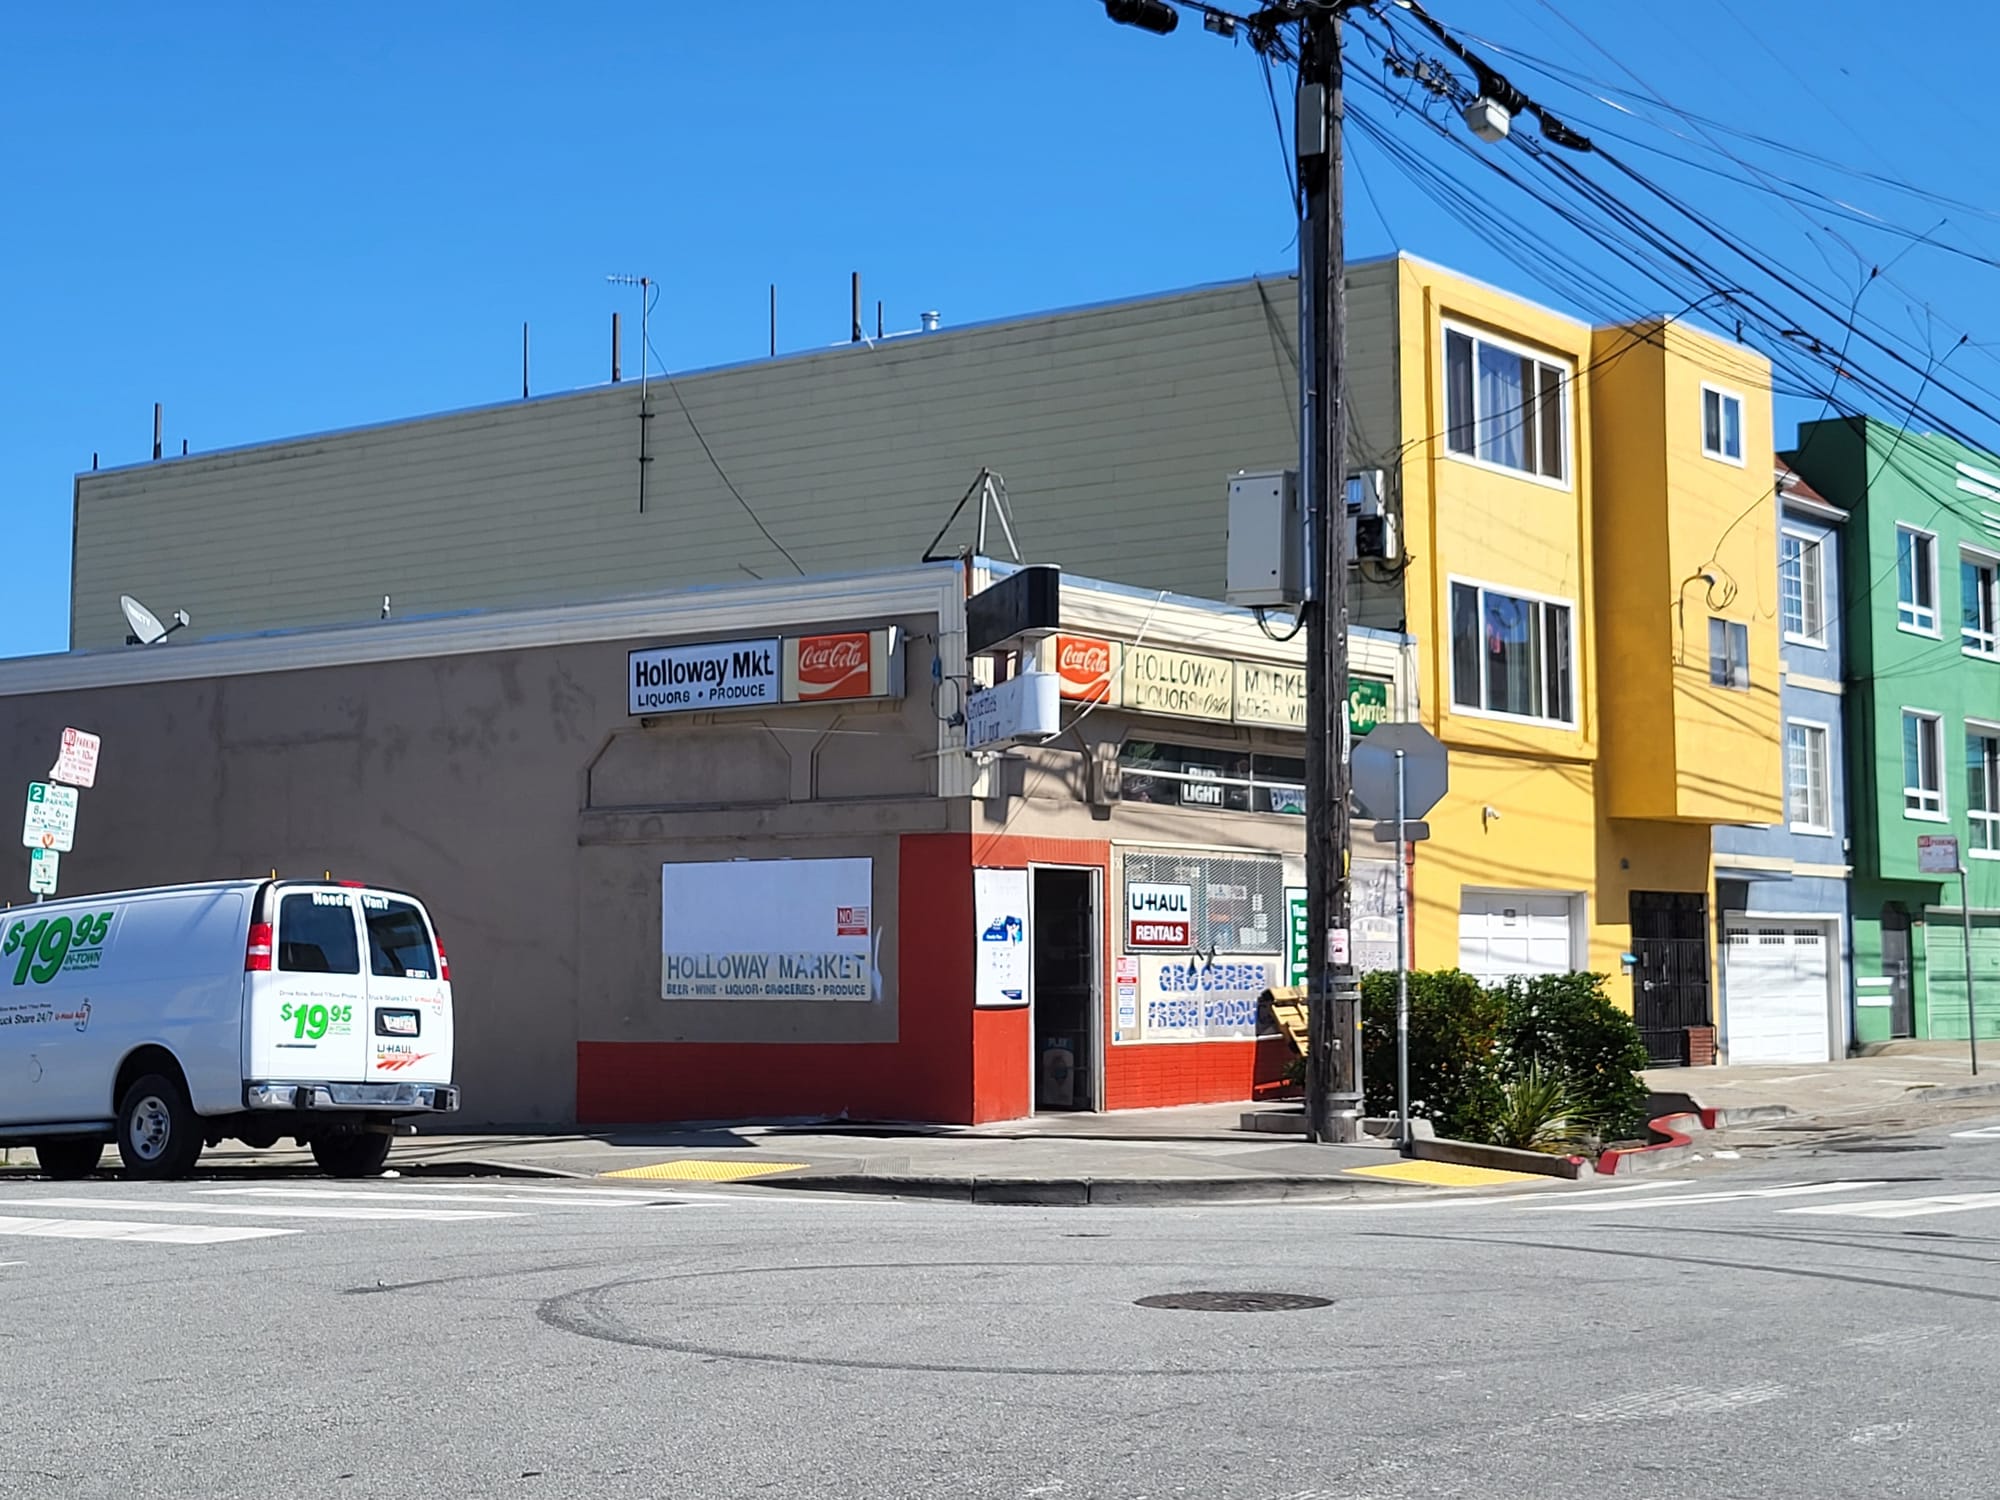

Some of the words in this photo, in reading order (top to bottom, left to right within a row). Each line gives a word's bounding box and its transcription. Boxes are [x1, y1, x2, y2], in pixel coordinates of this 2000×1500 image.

[800, 640, 863, 672] Coca-Cola
[1060, 643, 1108, 674] Coca-Cola
[636, 657, 728, 688] Holloway
[1245, 669, 1307, 698] MRKE
[638, 690, 690, 708] LIQUORS
[709, 683, 765, 700] PRODUCE
[1350, 690, 1387, 727] Sprite
[31, 786, 43, 801] 2
[1183, 784, 1221, 803] LIGHT
[313, 891, 343, 906] Need
[362, 895, 389, 911] Van?
[838, 909, 852, 923] NO
[1135, 925, 1184, 942] RENTALS
[668, 954, 769, 980] HOLLOWAY
[779, 954, 866, 980] MARKET
[1159, 963, 1265, 992] GROCERIES
[666, 983, 689, 996] BEER
[694, 983, 717, 996] WINE
[725, 983, 759, 996] LIQUOR
[765, 983, 815, 996] GROCERIES
[823, 983, 866, 996] PRODUCE
[1148, 1000, 1199, 1028] FRESH
[1204, 1000, 1258, 1027] PRODU
